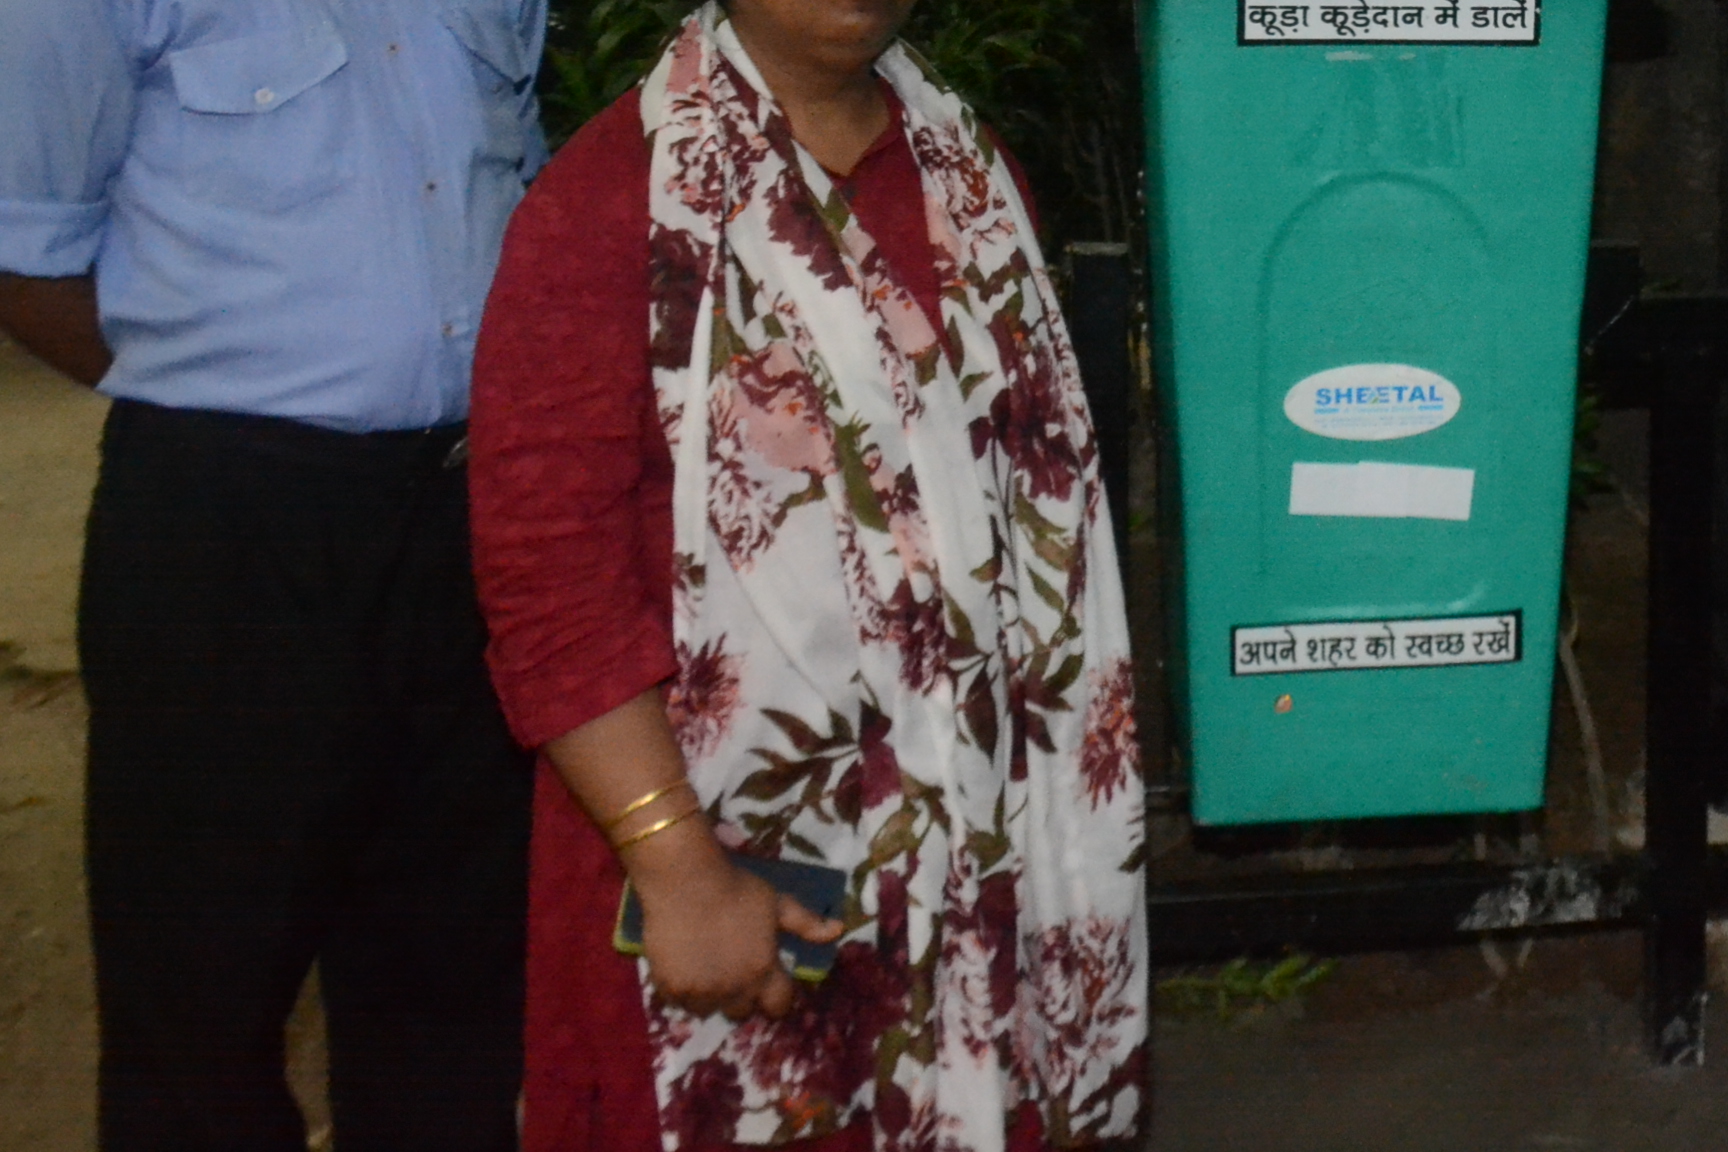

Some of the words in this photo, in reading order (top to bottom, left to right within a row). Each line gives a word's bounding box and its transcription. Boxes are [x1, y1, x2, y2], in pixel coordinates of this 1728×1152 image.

[1248, 4, 1309, 37] कूड़ा
[1315, 385, 1444, 406] SHEETAL
[1240, 627, 1296, 666] अपने
[1306, 637, 1357, 666] शहर
[1365, 623, 1395, 661] को
[1404, 632, 1465, 660] स्वच्छ
[1472, 618, 1512, 655] रखें
